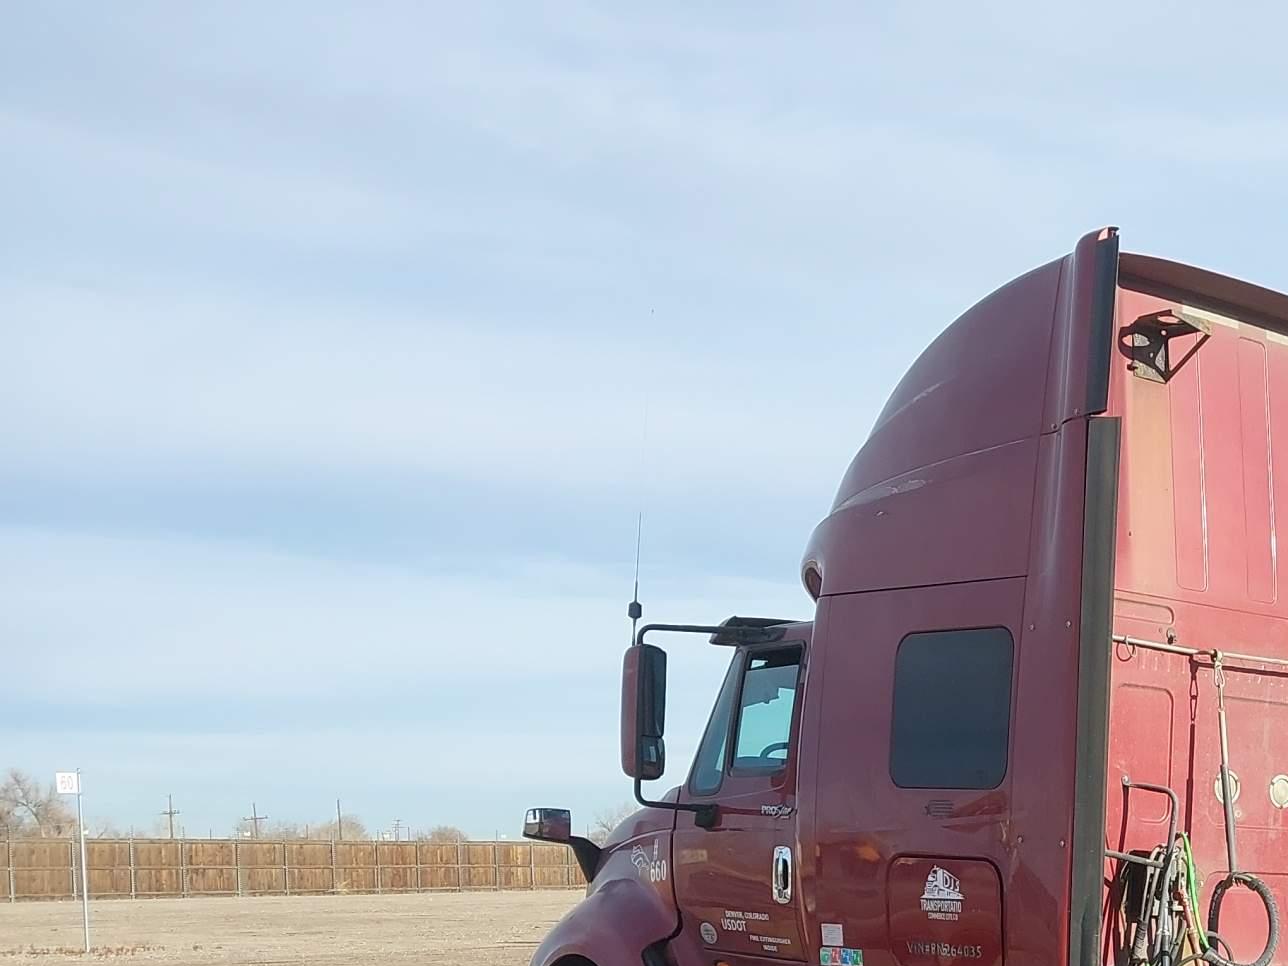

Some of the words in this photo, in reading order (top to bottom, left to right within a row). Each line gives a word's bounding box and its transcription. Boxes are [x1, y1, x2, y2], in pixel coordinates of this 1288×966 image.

[650, 860, 667, 882] 660
[744, 912, 769, 921] COLORADO
[720, 918, 747, 931] USDOT
